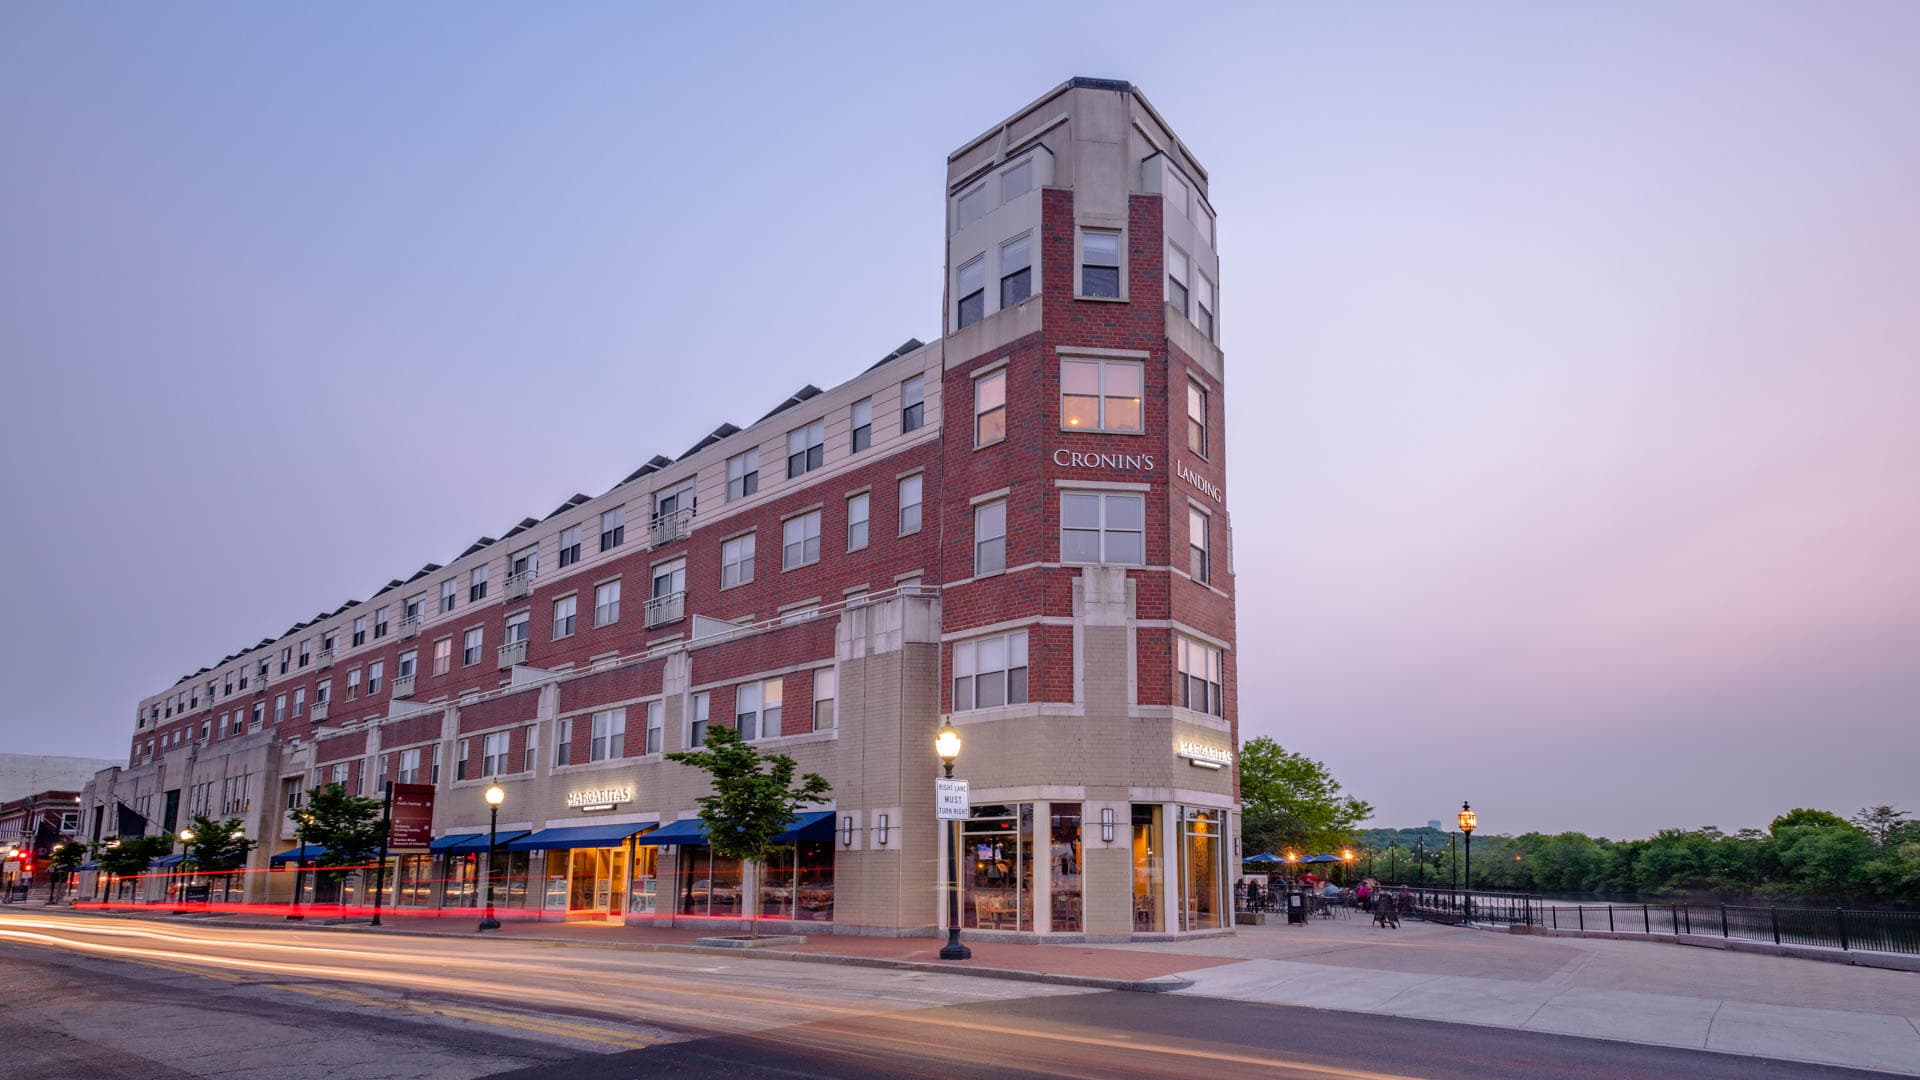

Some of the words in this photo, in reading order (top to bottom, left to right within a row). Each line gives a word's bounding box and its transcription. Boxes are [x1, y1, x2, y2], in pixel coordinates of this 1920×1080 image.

[1053, 449, 1154, 470] CRONIN'S
[1177, 459, 1222, 503] LANDING
[1180, 741, 1233, 762] MARGARITAS
[567, 787, 631, 805] MARGARITAS
[945, 795, 962, 804] MUST
